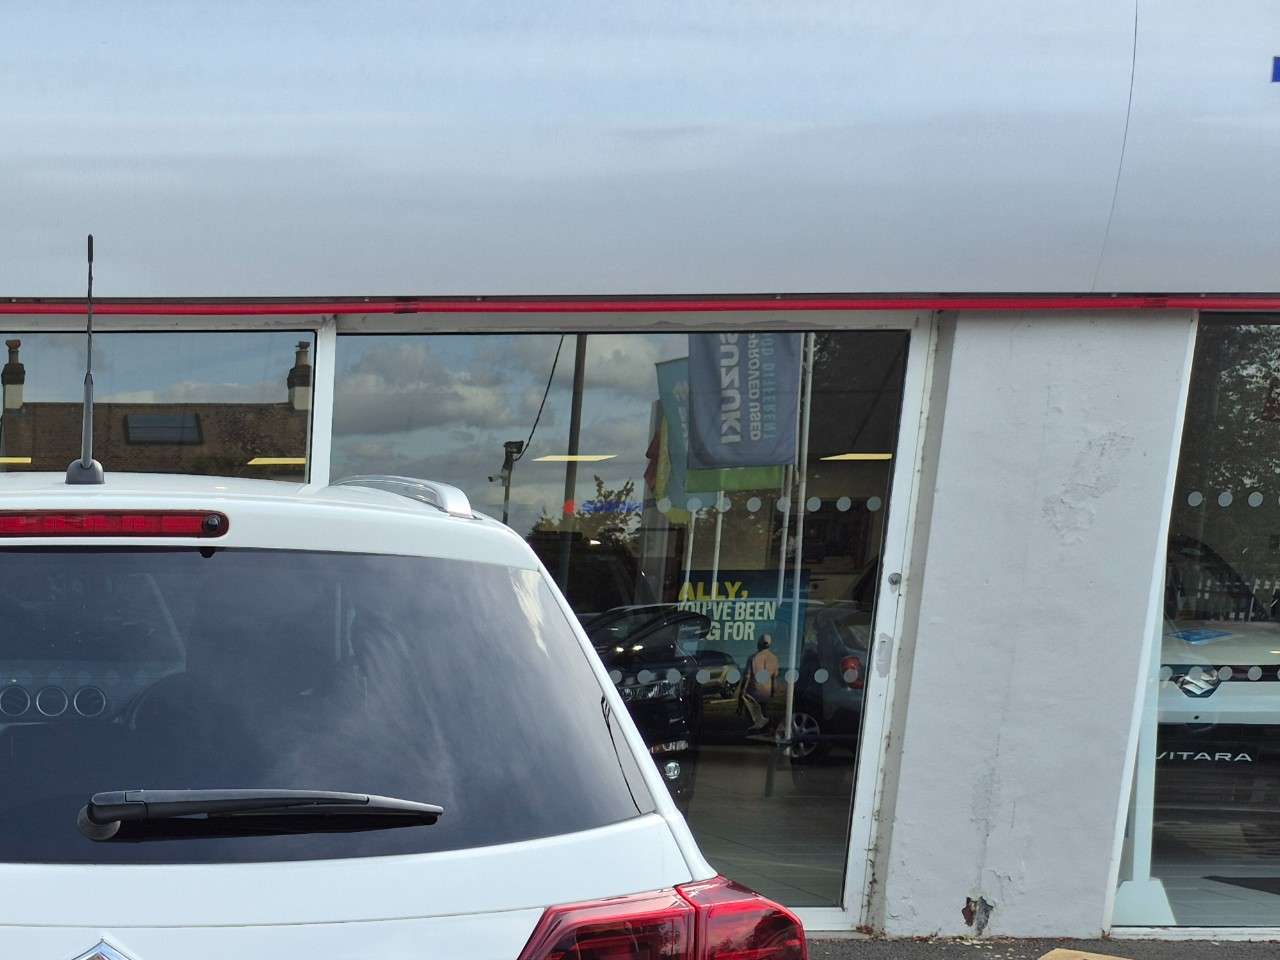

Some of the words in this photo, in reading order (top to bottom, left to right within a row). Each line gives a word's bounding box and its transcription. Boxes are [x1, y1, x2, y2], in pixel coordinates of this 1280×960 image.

[734, 601, 777, 620] BEEN
[723, 621, 756, 641] FOR
[1155, 751, 1253, 762] VITARA
